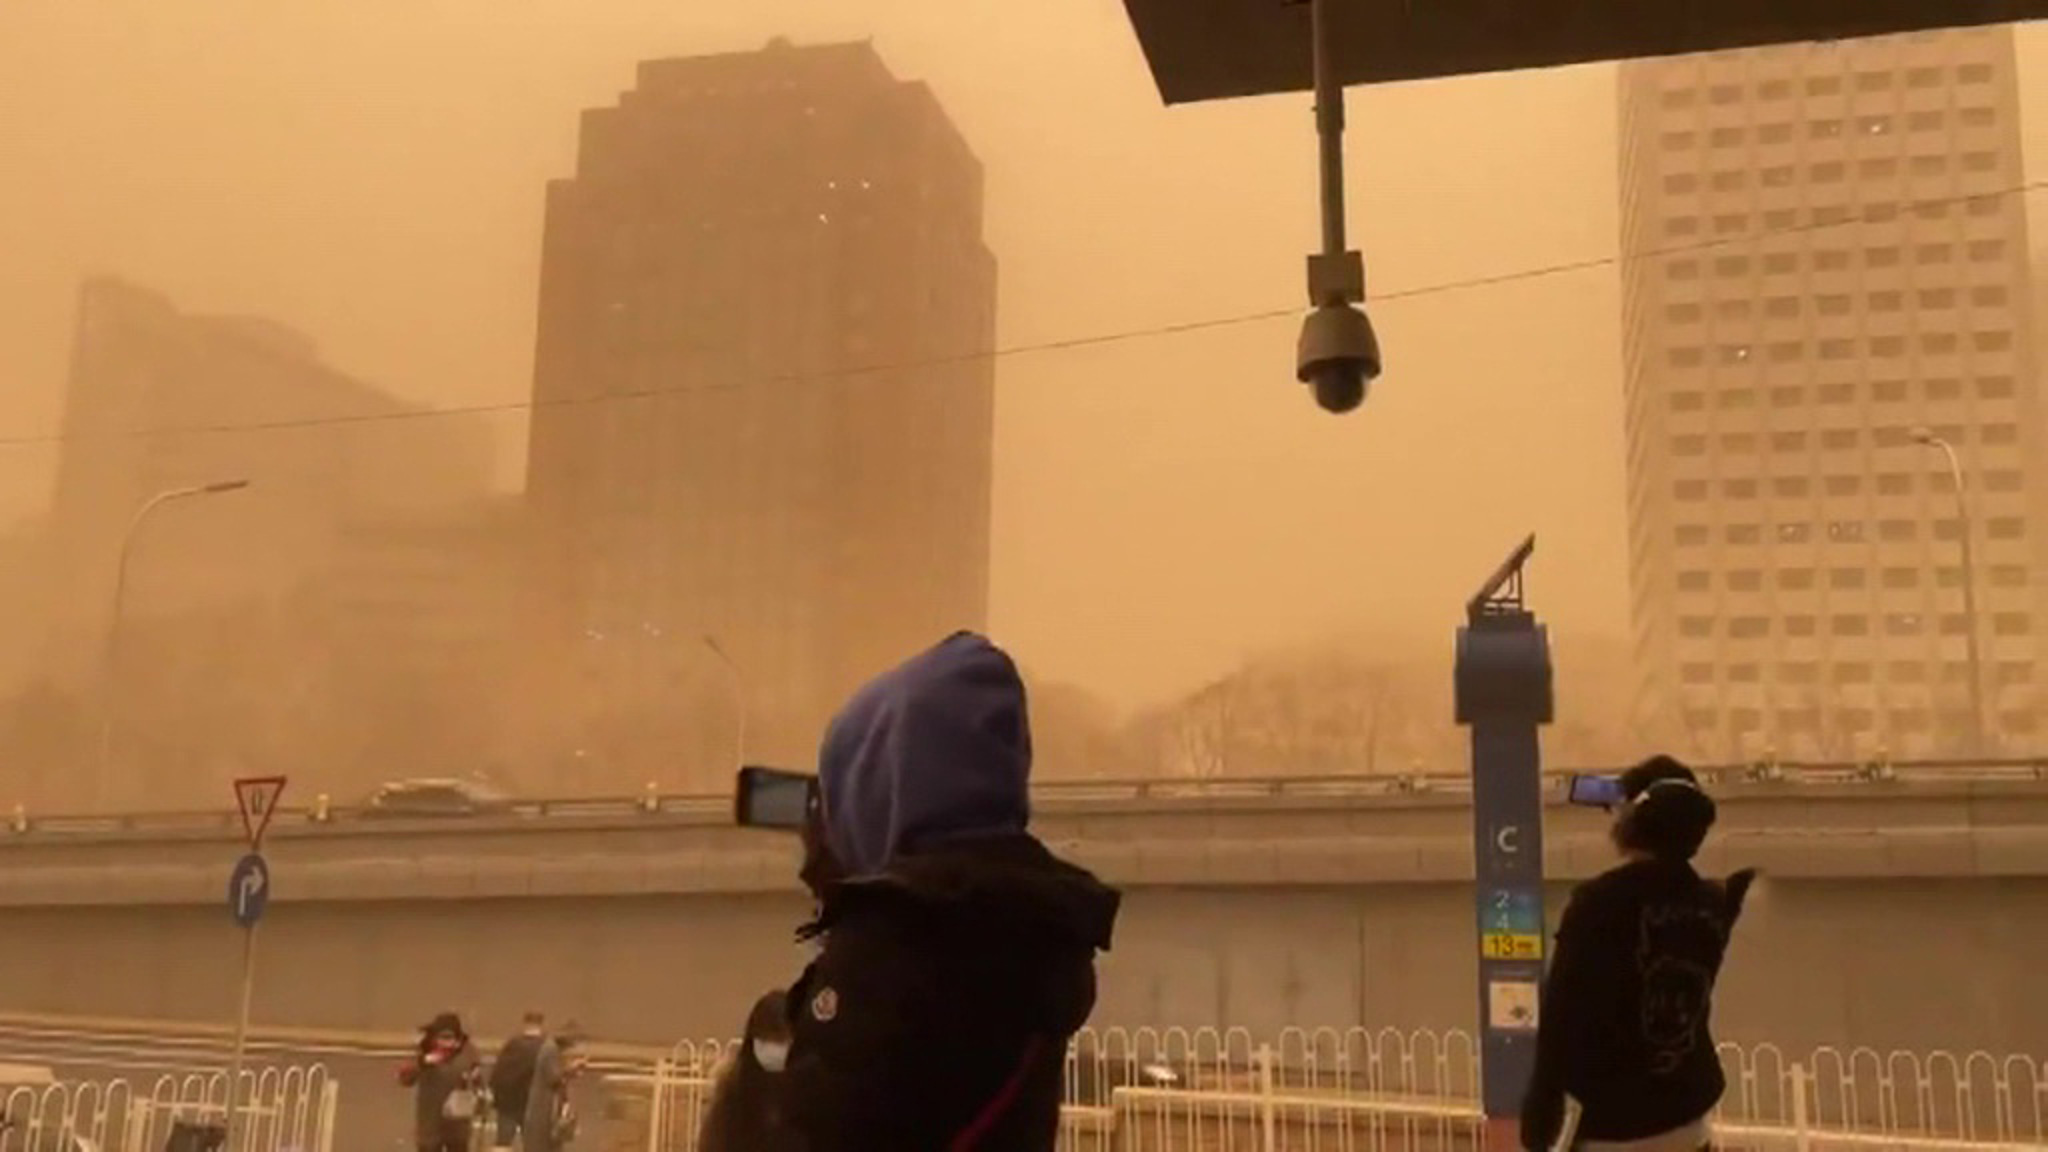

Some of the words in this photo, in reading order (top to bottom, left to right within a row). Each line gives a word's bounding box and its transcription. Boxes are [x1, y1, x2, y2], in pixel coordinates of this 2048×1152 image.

[1497, 826, 1518, 852] C
[1496, 890, 1510, 908] 2
[1491, 935, 1515, 955] 13
